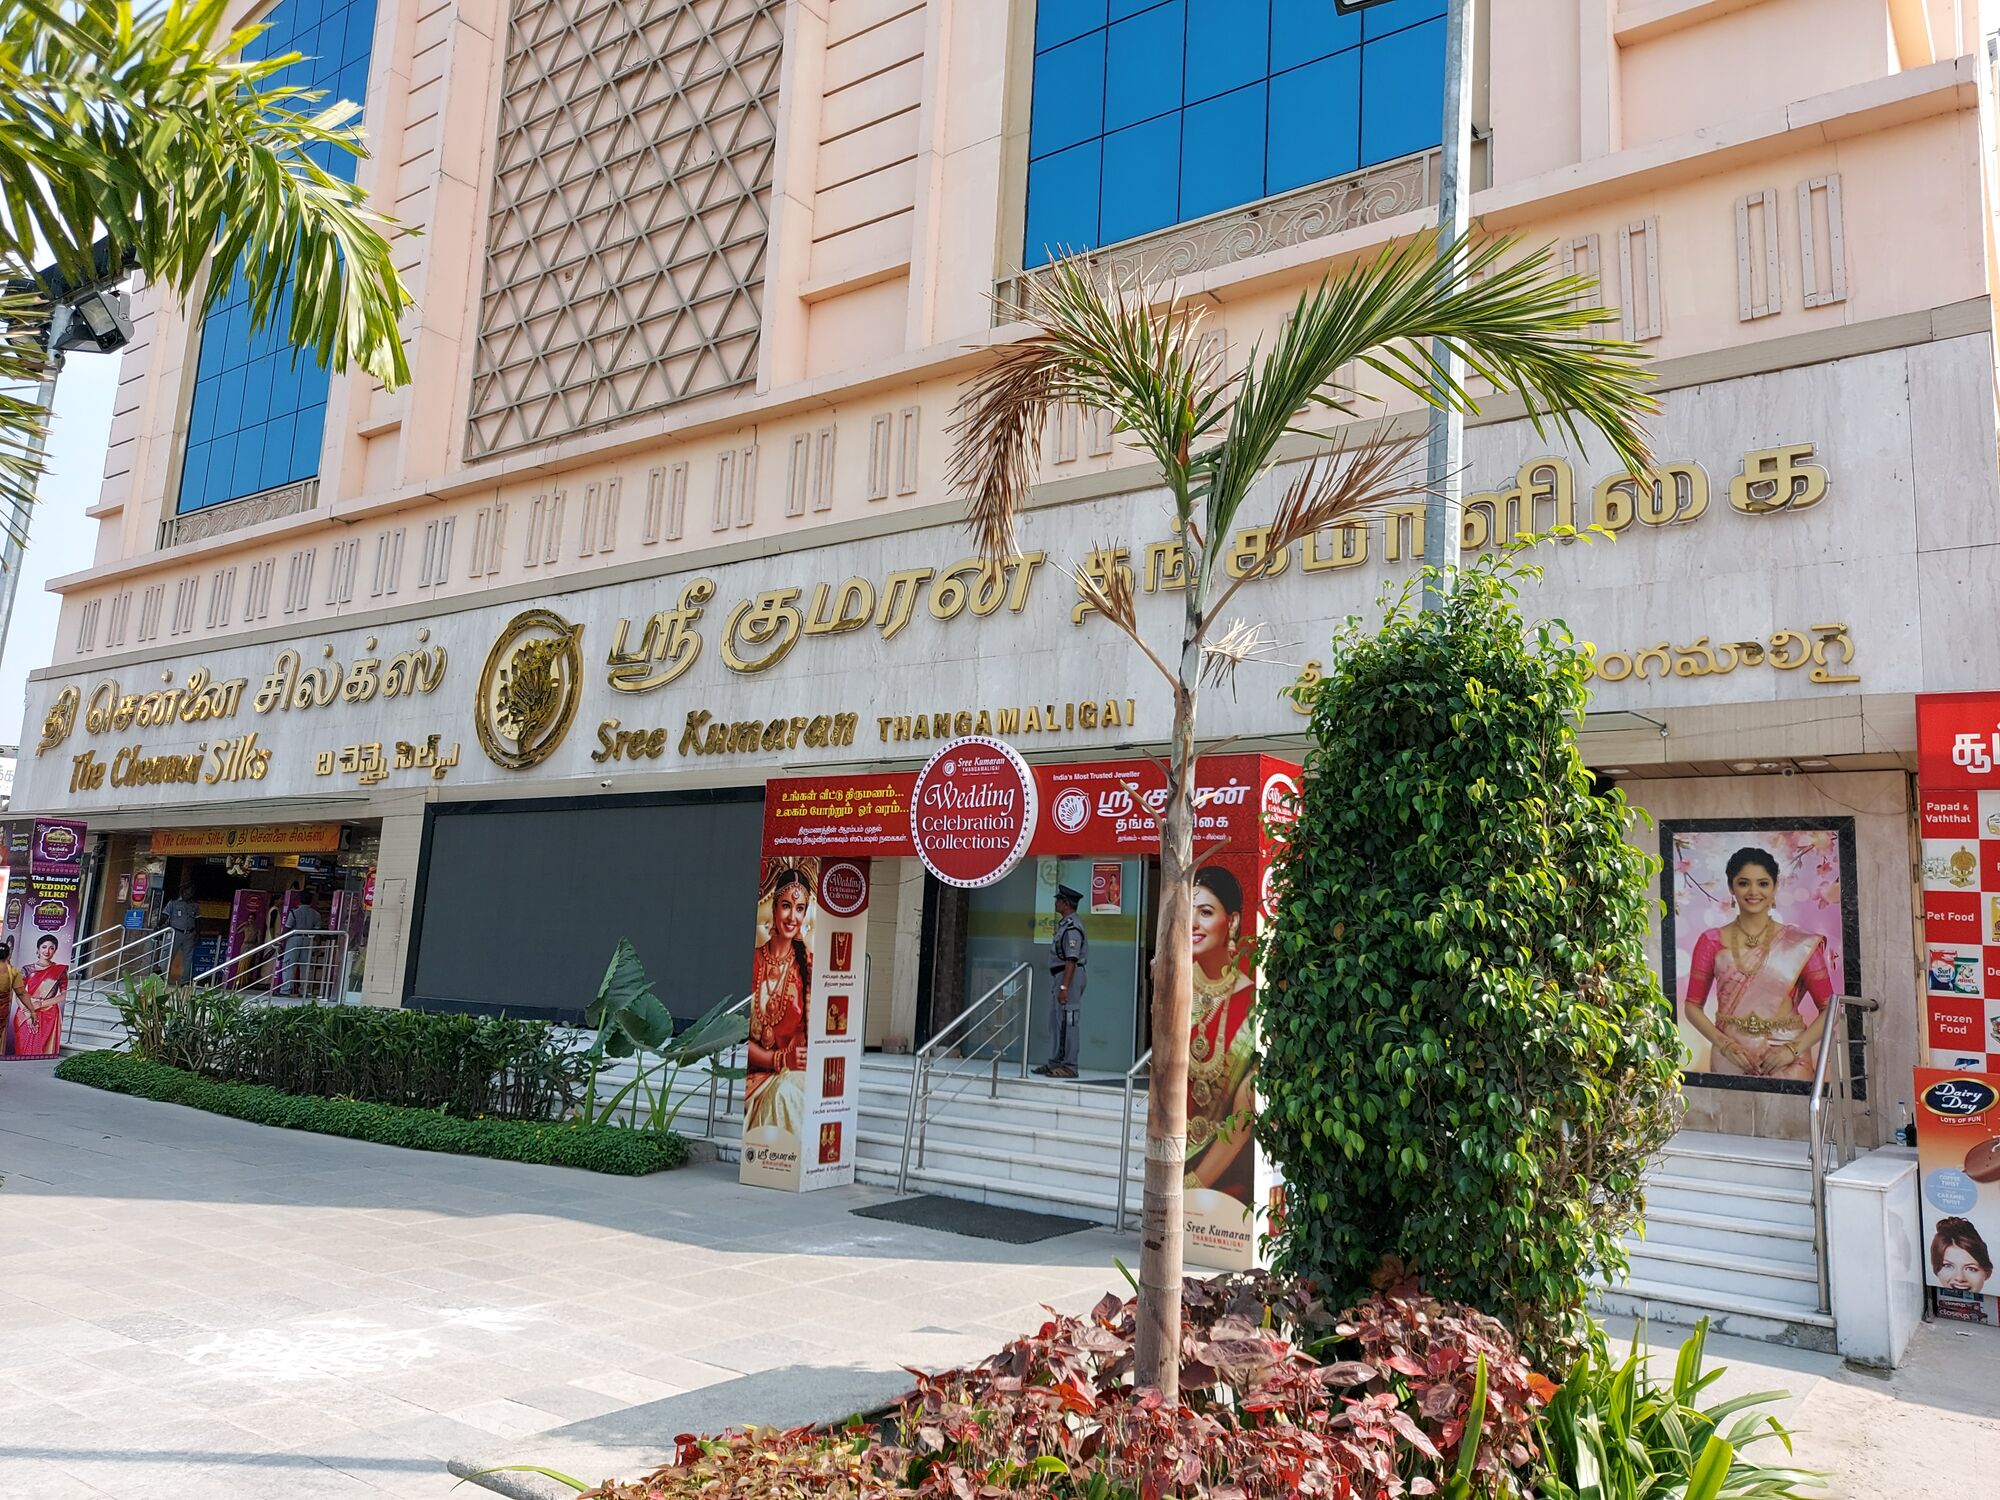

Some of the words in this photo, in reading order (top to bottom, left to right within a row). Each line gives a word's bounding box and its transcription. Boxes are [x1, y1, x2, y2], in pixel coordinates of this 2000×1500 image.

[607, 576, 717, 694] ஸ்ரீ
[35, 683, 80, 758] தி
[85, 665, 248, 735] சென்னை
[253, 627, 447, 714] சில்க்ஸ்
[591, 718, 667, 763] Sree
[678, 709, 858, 757] Kumaran
[877, 699, 1136, 742] THANGAMALIGAI
[69, 750, 106, 793] The
[111, 744, 207, 788] Chennai
[203, 732, 272, 784] Silks
[957, 757, 973, 767] Sree
[974, 757, 1006, 766] Kumaran
[782, 790, 817, 802] உங்கள்
[819, 788, 843, 801] வீட்டு
[924, 781, 1015, 816] Wedding
[776, 803, 808, 817] உலகம்
[809, 801, 853, 818] போற்றும்
[1926, 802, 1960, 813] Papad
[1963, 803, 1969, 811] &
[922, 814, 1014, 831] Celebration
[1925, 814, 1971, 824] Vaththal
[864, 823, 882, 834] முதல்
[162, 834, 174, 847] The
[176, 833, 205, 847] Chennai
[206, 831, 224, 846] Silks
[925, 834, 1010, 850] Collections
[46, 875, 71, 884] Beauty
[32, 882, 76, 891] WEDDING
[39, 890, 68, 898] SILKS!
[1927, 912, 1945, 921] Pet
[1948, 912, 1974, 922] Food
[1937, 966, 1952, 975] Surf
[1934, 1012, 1973, 1024] Frozen
[1940, 1024, 1967, 1034] Food
[1935, 1083, 1982, 1102] Dairy
[1941, 1095, 1977, 1114] Day
[1940, 1116, 1956, 1124] LOTS
[1937, 1192, 1966, 1201] CARAMEL
[1186, 1221, 1206, 1234] Sree
[1209, 1225, 1251, 1242] Kumaran
